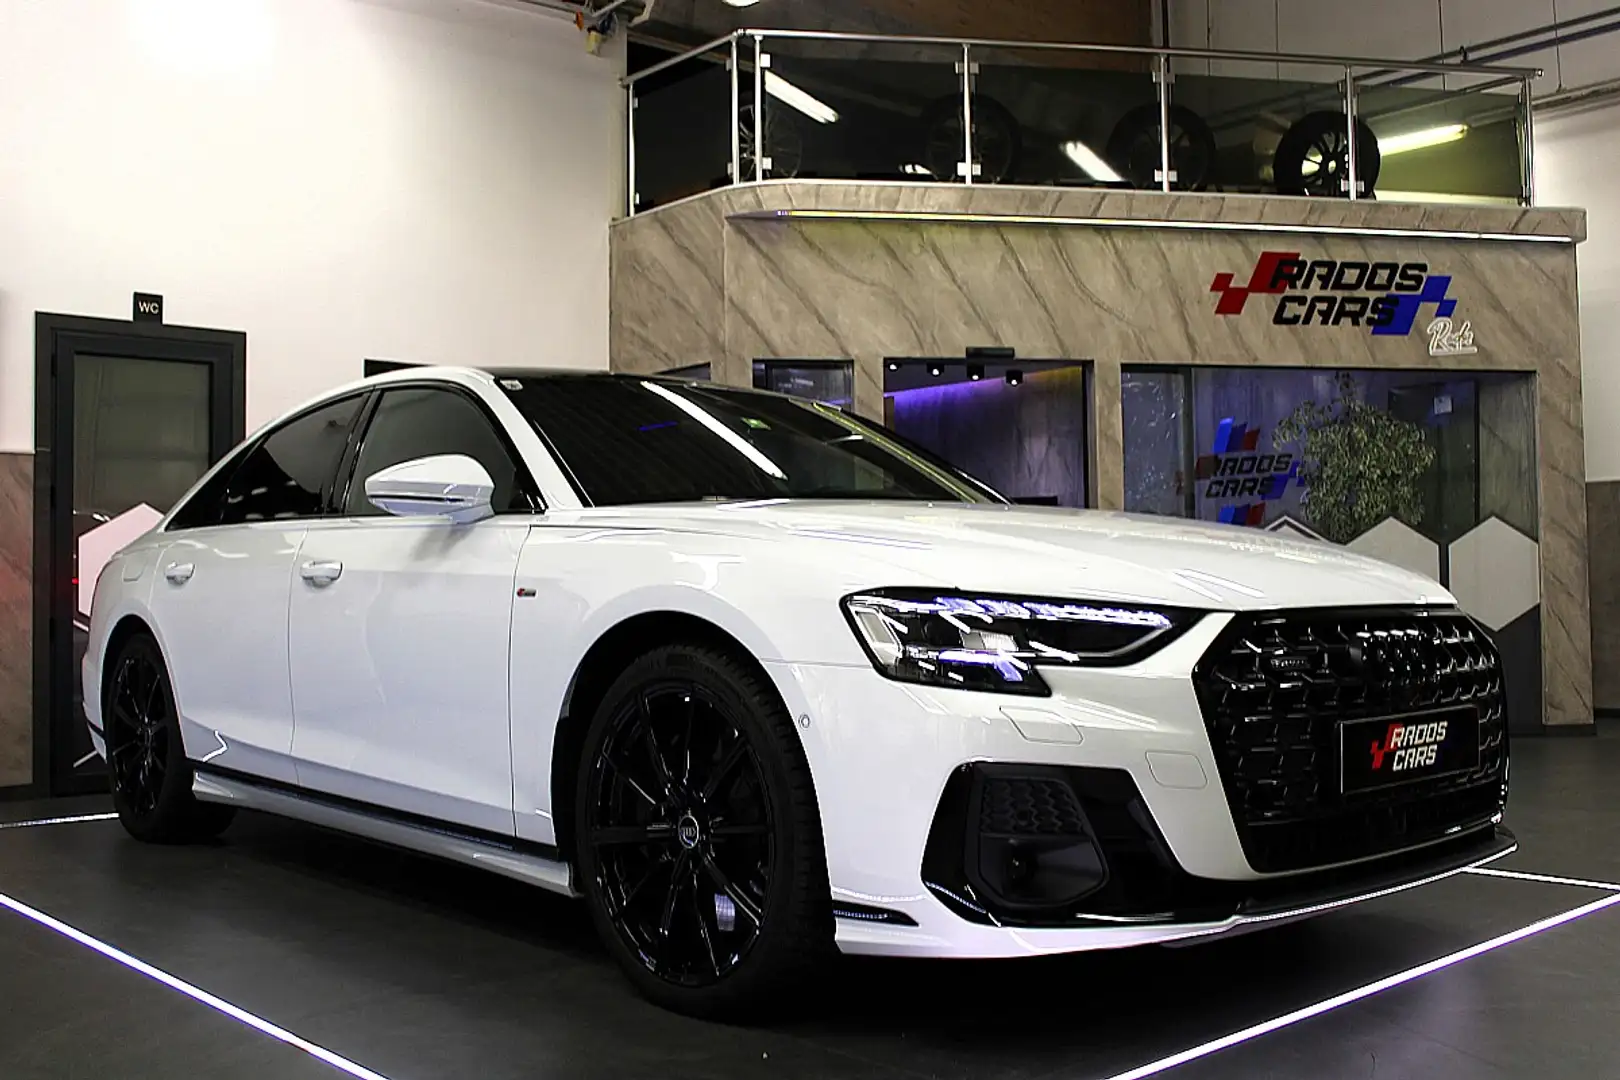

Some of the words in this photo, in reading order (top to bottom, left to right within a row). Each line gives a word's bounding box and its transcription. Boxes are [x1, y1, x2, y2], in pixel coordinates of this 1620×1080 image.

[1270, 259, 1428, 292] RADOS
[138, 300, 160, 315] WC
[1272, 295, 1399, 327] CARS
[1390, 720, 1449, 750] RADOS
[1392, 744, 1438, 772] CARS
